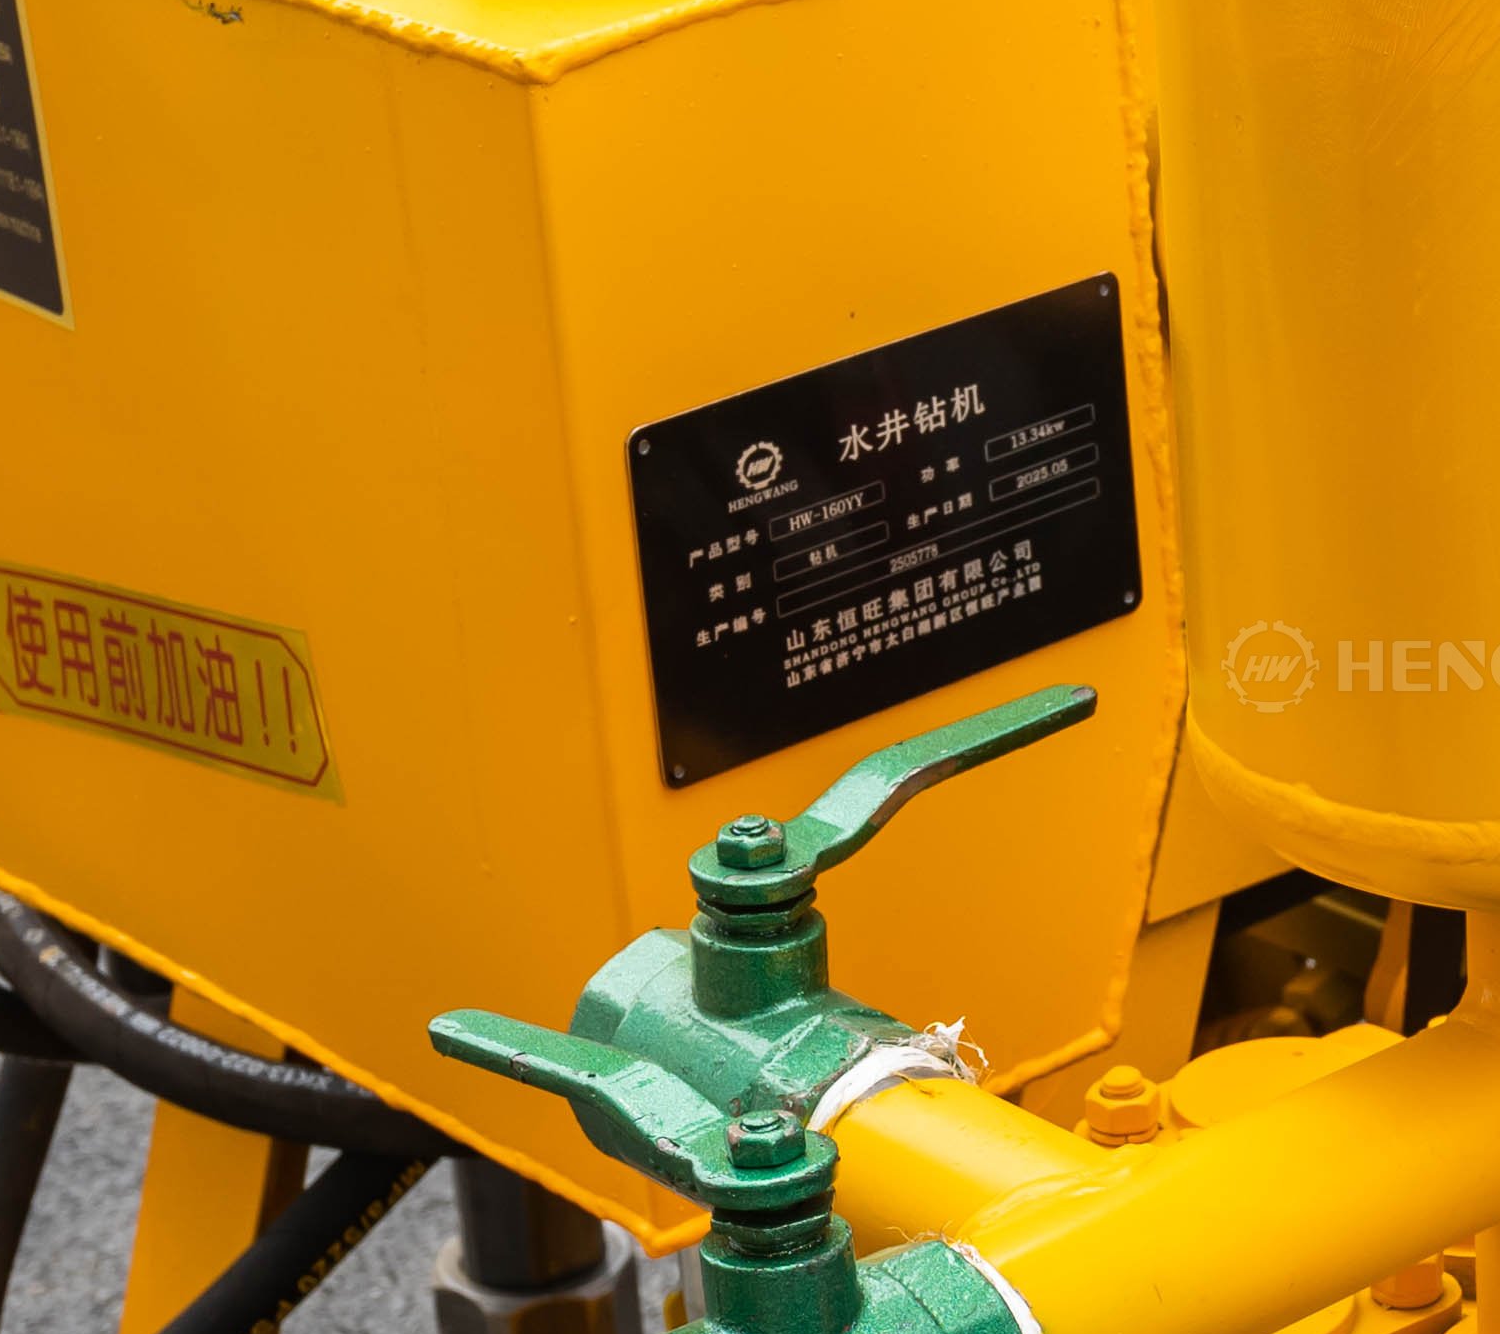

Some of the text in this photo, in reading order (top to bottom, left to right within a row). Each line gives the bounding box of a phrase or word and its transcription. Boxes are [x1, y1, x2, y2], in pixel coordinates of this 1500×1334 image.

[838, 383, 986, 462] 水井钻机
[728, 479, 799, 513] HENGWANG
[789, 492, 863, 532] HW-160YY
[689, 529, 759, 568] 产品型号
[786, 539, 1037, 652] 山东恒旺集团有限公司
